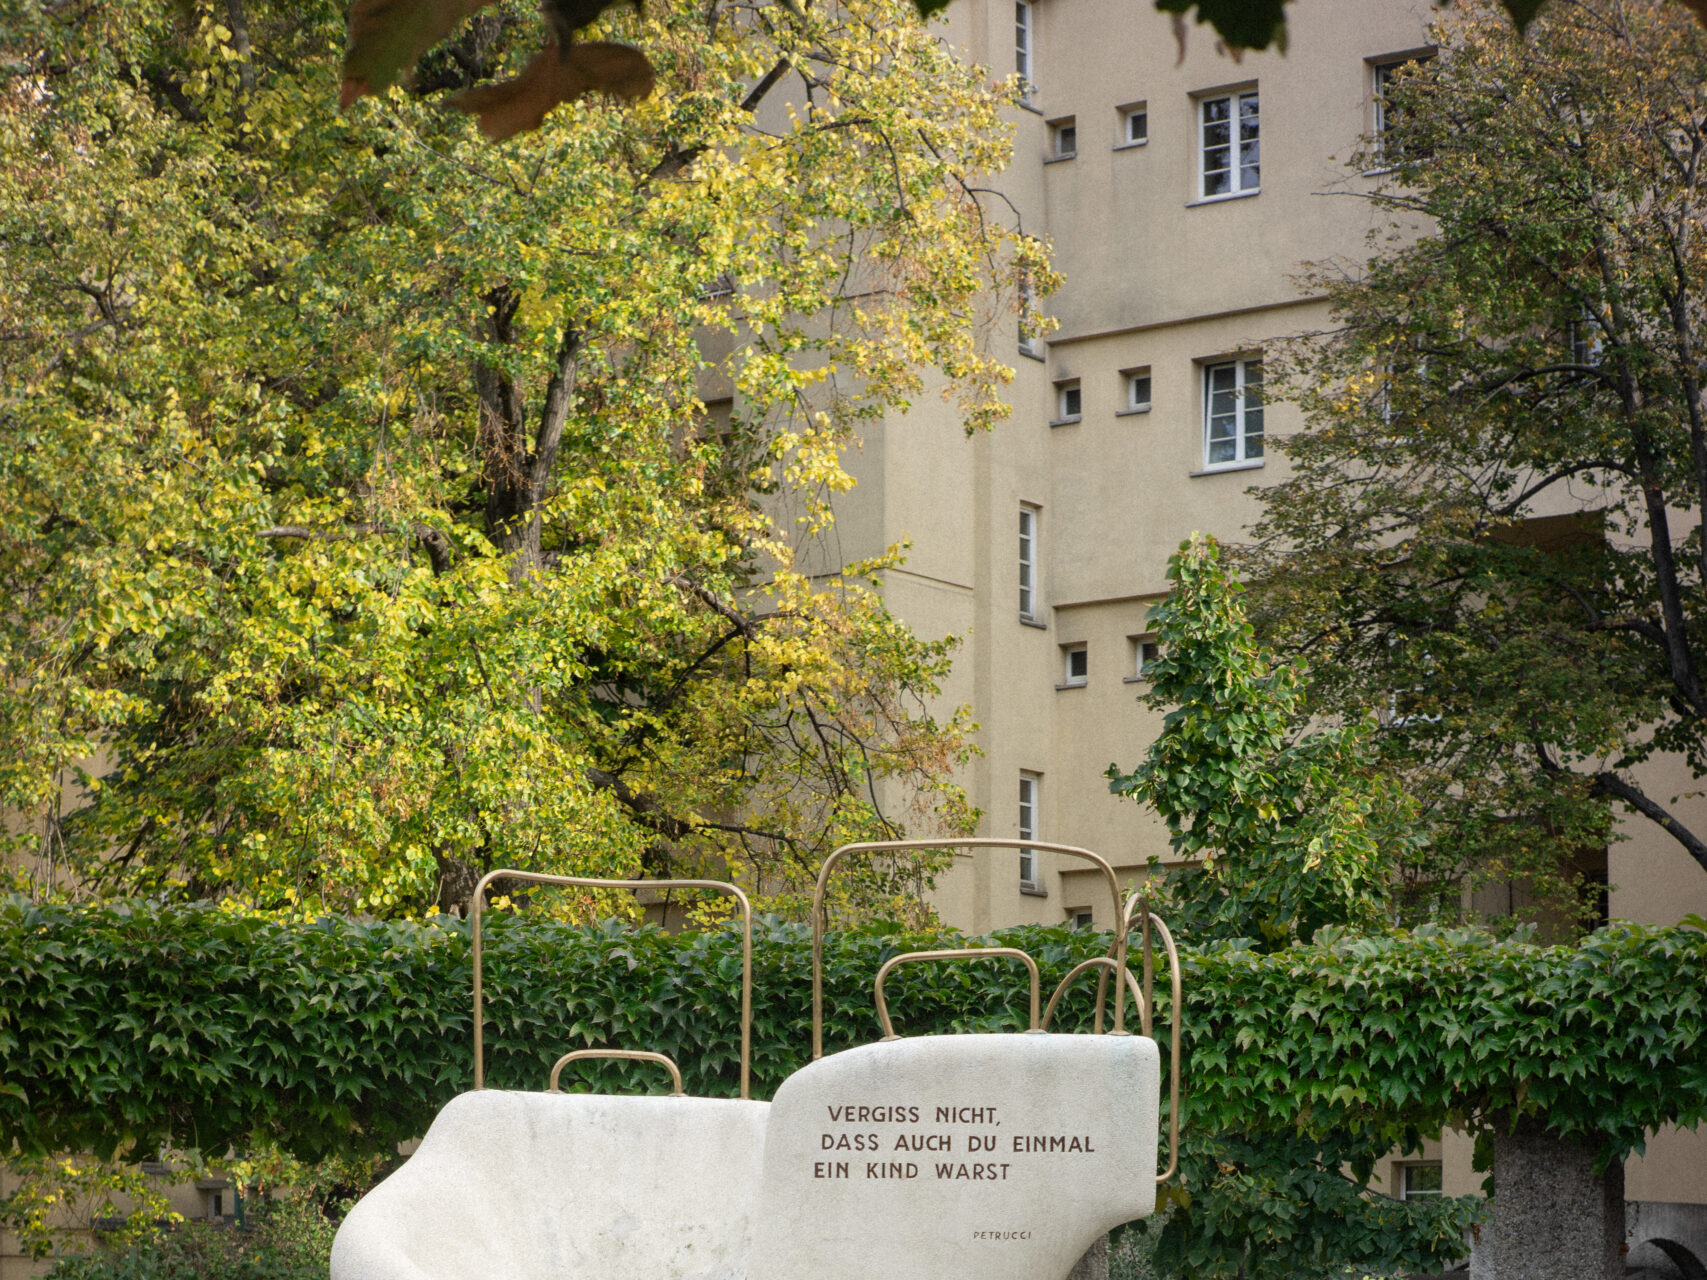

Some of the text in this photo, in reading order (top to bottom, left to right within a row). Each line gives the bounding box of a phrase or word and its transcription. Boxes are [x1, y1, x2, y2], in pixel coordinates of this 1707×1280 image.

[827, 1105, 1001, 1127] VERGISS NICHT,
[821, 1133, 1095, 1153] DASS AUCH DU EINMAL
[814, 1161, 1010, 1180] EIN KIND WARST
[973, 1231, 1032, 1240] PETRUCCI
